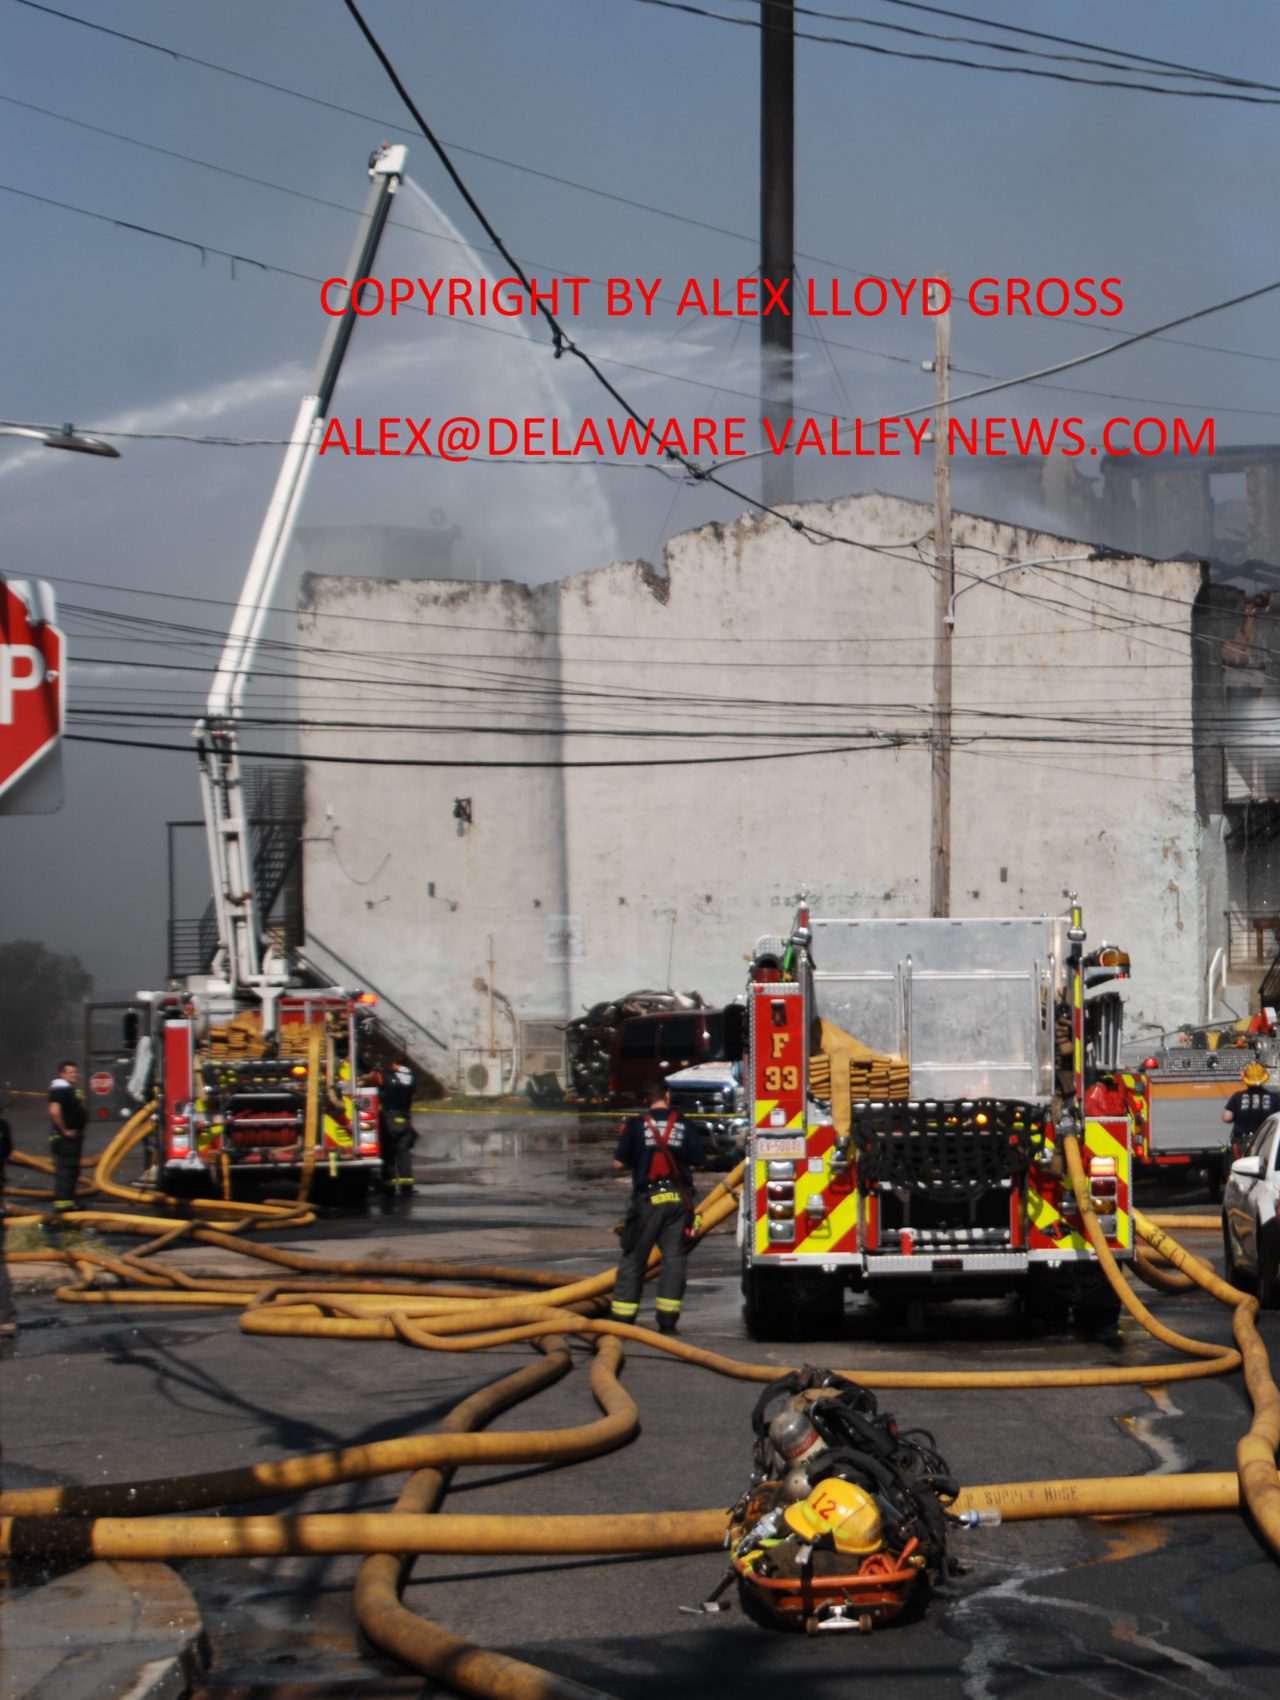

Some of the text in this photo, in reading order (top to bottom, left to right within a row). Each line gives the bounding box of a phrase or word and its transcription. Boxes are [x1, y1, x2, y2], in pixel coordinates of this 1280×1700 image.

[771, 1032, 790, 1059] F
[90, 1078, 114, 1088] STOP
[764, 1066, 799, 1092] 33
[811, 1491, 838, 1521] 12
[984, 1487, 1035, 1505] SUPPLY
